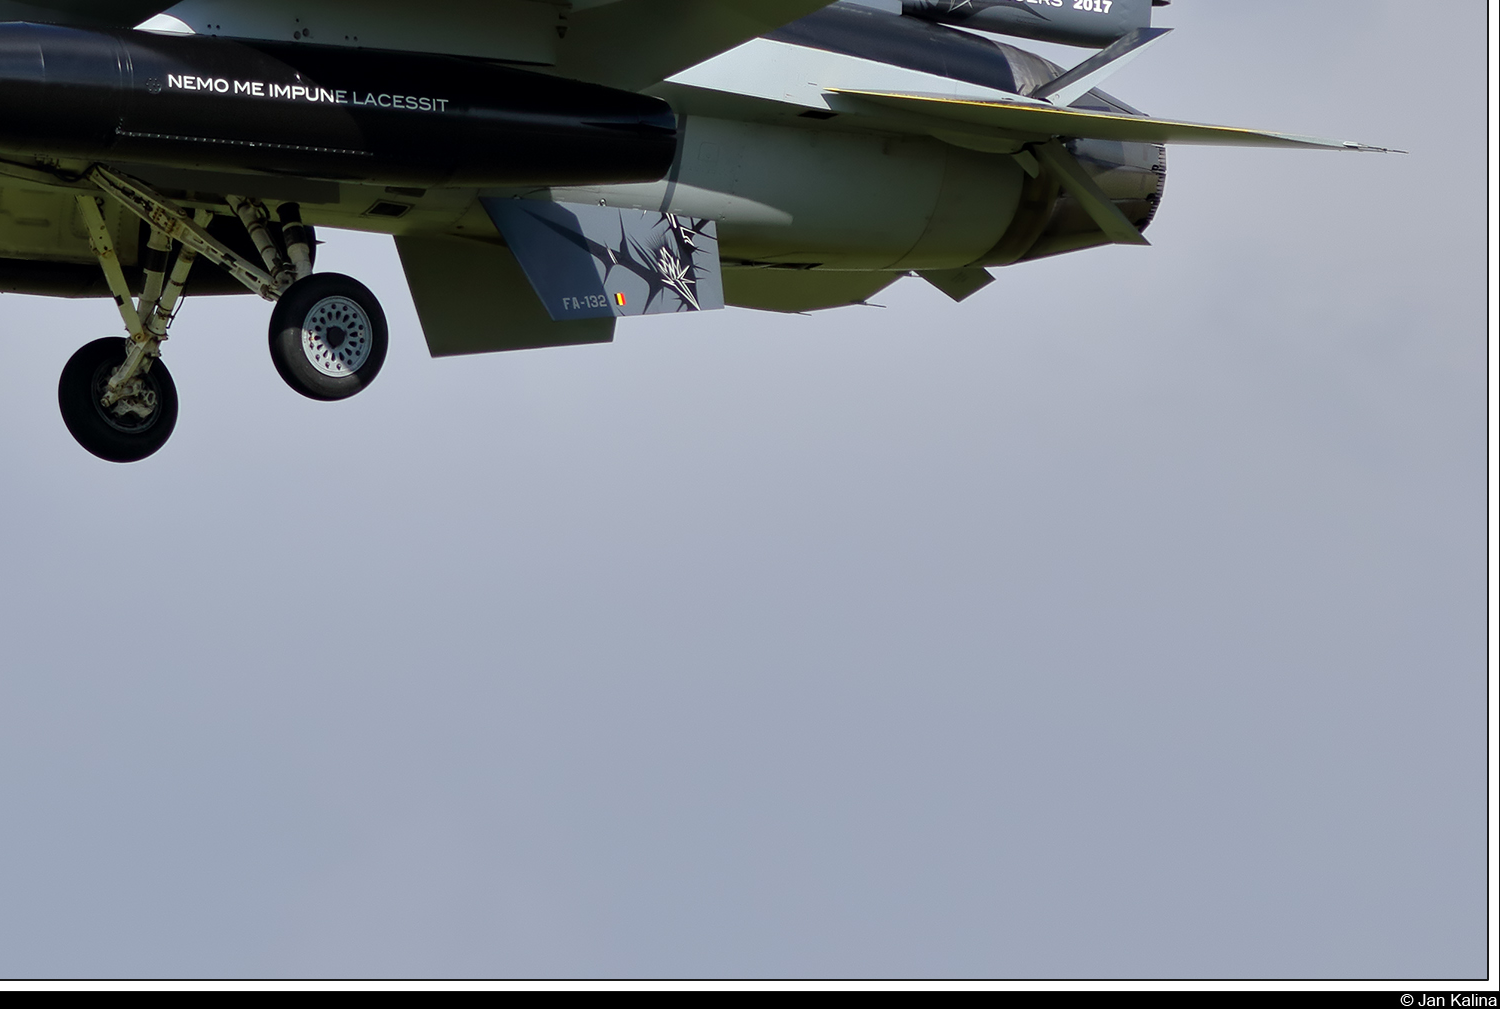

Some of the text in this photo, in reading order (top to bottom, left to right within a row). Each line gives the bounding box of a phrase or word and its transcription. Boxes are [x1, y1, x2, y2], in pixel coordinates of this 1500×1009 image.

[167, 73, 449, 112] NEMO ME IMPUNE LACESSIT
[562, 294, 608, 310] FA-132
